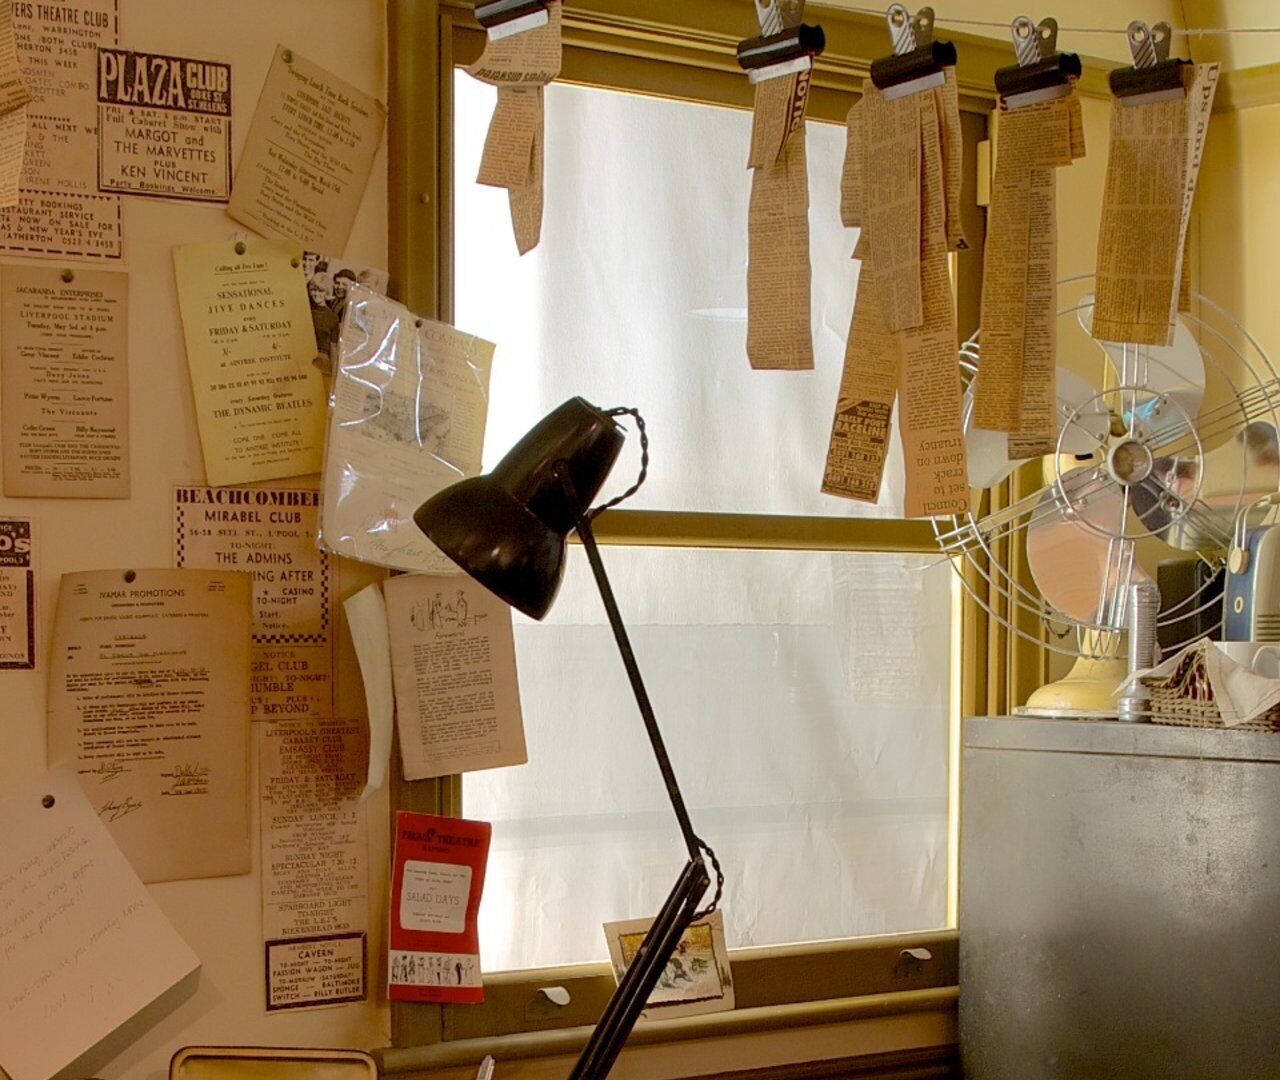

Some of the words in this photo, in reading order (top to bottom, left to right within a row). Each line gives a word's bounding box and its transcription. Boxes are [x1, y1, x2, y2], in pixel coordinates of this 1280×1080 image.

[37, 5, 79, 24] THEATRE
[83, 11, 109, 28] CLUB
[43, 26, 101, 38] WARRINGTON
[28, 57, 48, 66] THIS
[55, 59, 78, 69] WEEK
[99, 52, 186, 108] PLAZA
[186, 62, 228, 92] CLUB
[32, 122, 48, 130] ALL
[56, 124, 77, 133] NEXT
[124, 127, 179, 143] MARGOT
[185, 134, 204, 146] and
[114, 141, 138, 155] THE
[146, 144, 216, 163] MARVETTES
[154, 160, 177, 169] PLUS
[120, 164, 146, 178] KEN
[153, 167, 209, 184] VINCENT
[110, 178, 132, 189] Party
[139, 181, 175, 193] Bookings
[41, 200, 83, 211] BOOKINGS
[60, 210, 94, 221] SERVICE
[20, 216, 41, 225] NOW
[69, 220, 89, 229] SALE
[98, 222, 113, 231] FOR
[29, 225, 48, 234] NEW
[217, 287, 273, 299] SENSATIONAL
[208, 304, 234, 315] JIVE
[239, 300, 285, 312] DANCES
[20, 311, 69, 321] LIVERPOOL
[74, 314, 114, 323] STADIUM
[209, 324, 239, 337] FRIDAY
[249, 320, 293, 333] SATURDAY
[212, 408, 231, 419] THE
[233, 404, 273, 417] DYNAMIC
[276, 400, 313, 413] BEATLES
[920, 438, 962, 452] truancy
[917, 458, 930, 466] on
[934, 453, 963, 464] down
[933, 469, 964, 482] crack
[934, 485, 945, 495] to
[948, 484, 965, 493] set
[923, 499, 968, 515] Council
[205, 510, 261, 523] MIRABEL
[269, 511, 301, 524] CLUB
[215, 552, 238, 564] THE
[246, 553, 293, 565] ADMINS
[280, 571, 314, 582] AFTER
[130, 589, 185, 598] PROMOTIONS
[278, 661, 308, 670] CLUB
[264, 704, 310, 714] BEYOND
[436, 894, 460, 906] DAYS
[298, 949, 334, 959] CAVERN
